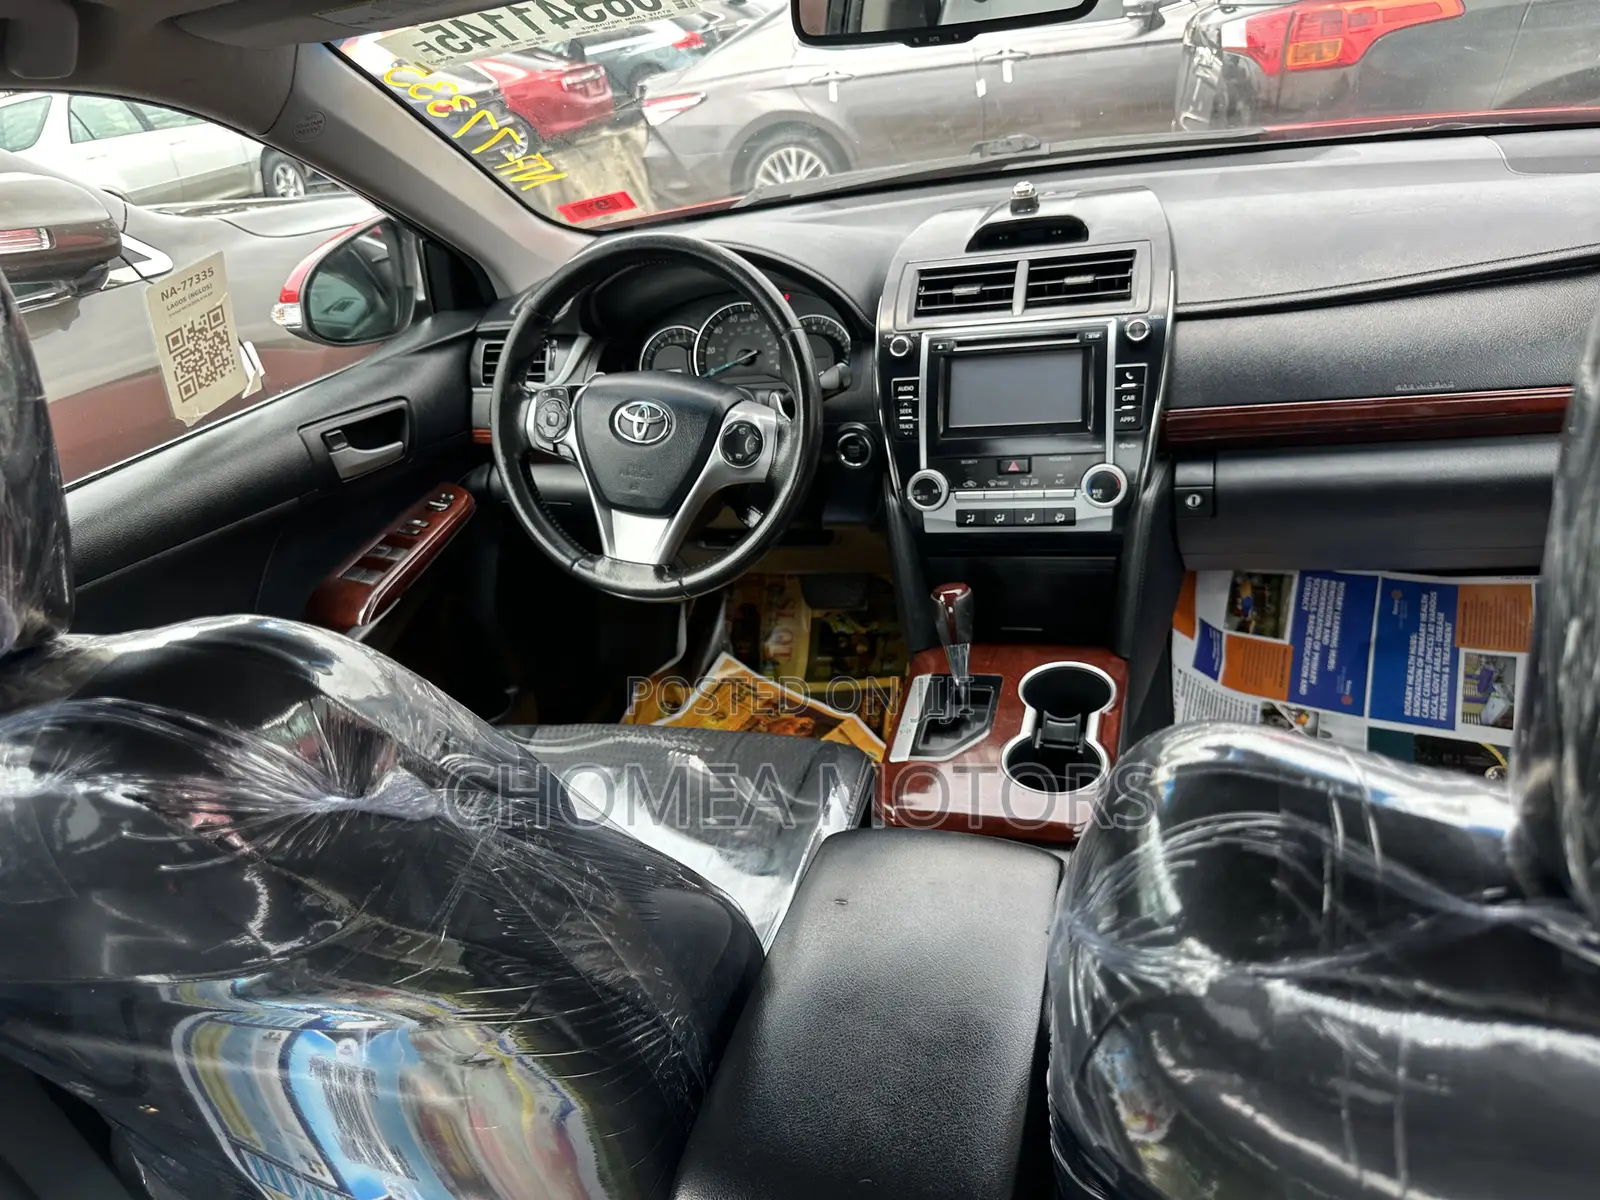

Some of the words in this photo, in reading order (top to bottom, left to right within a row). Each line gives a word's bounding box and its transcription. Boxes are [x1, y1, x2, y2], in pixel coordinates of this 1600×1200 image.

[160, 266, 215, 302] NA-77335
[166, 296, 188, 311] LAGOS
[188, 282, 213, 300] (NGLOS)
[1420, 593, 1429, 622] HEALTH
[1417, 622, 1428, 657] PRIMARY
[1435, 612, 1445, 642] DISEASE
[1442, 621, 1453, 666] TREATMENT
[1406, 655, 1416, 685] HEALTH
[1416, 657, 1424, 668] OF
[1433, 647, 1442, 673] AREAS
[1412, 669, 1423, 718] RENOVATION
[1422, 664, 1433, 697] CENTERS
[1404, 686, 1414, 717] ROTARY
[1421, 697, 1431, 718] CARE
[1430, 694, 1439, 720] LOCAL
[1438, 673, 1450, 720] PREVENTION
